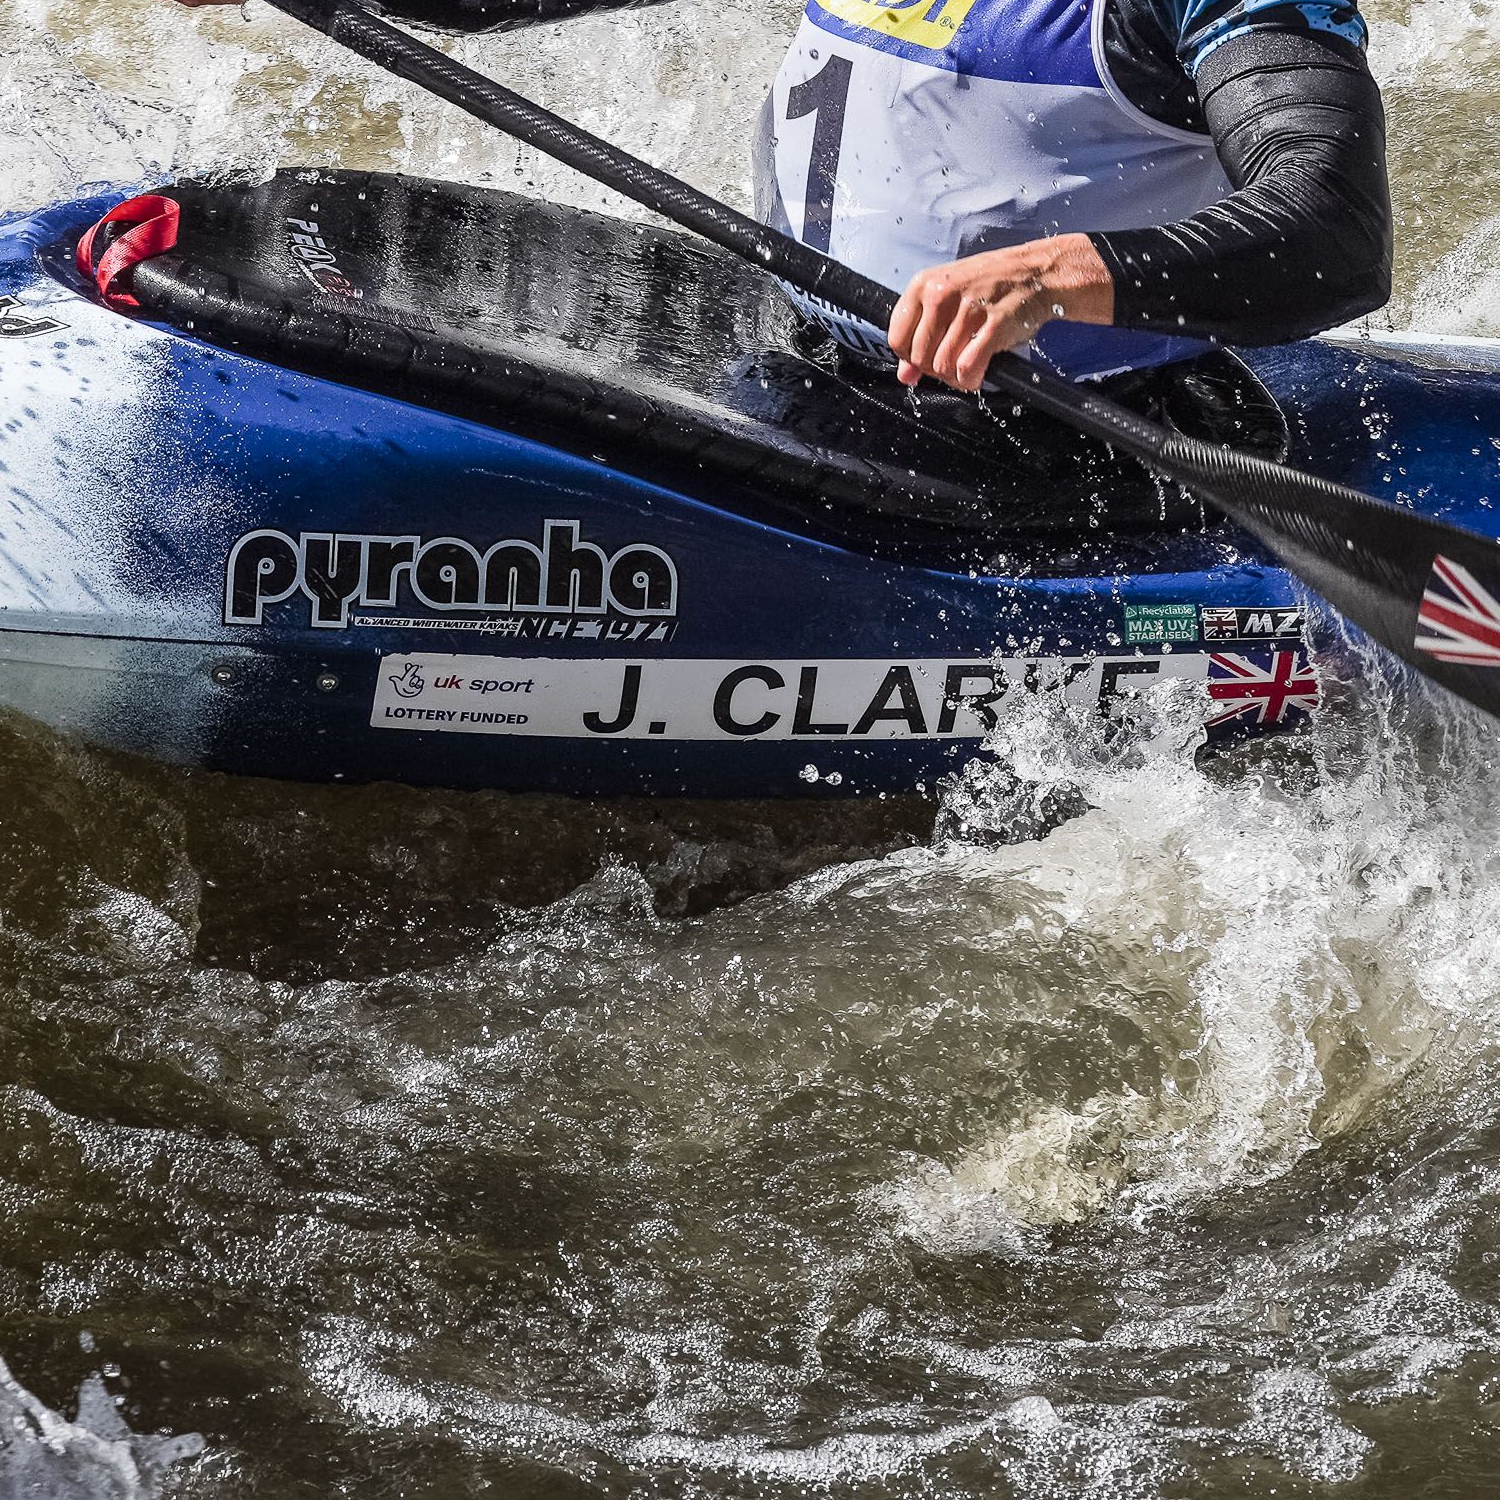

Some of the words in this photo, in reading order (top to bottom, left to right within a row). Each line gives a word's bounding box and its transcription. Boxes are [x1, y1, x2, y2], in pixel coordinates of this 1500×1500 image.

[786, 54, 854, 255] 1
[225, 519, 678, 629] pyranha
[1142, 606, 1193, 617] Recyclable
[411, 618, 479, 631] WHITEWATER
[479, 621, 520, 631] KAYAKS
[1128, 620, 1164, 632] MAX
[1167, 619, 1188, 631] UV
[1129, 631, 1190, 641] STABILISED
[433, 674, 465, 690] uk
[469, 679, 535, 695] sport
[582, 664, 667, 735] J.
[384, 707, 457, 722] LOTTERY
[460, 711, 529, 725] FUNDED
